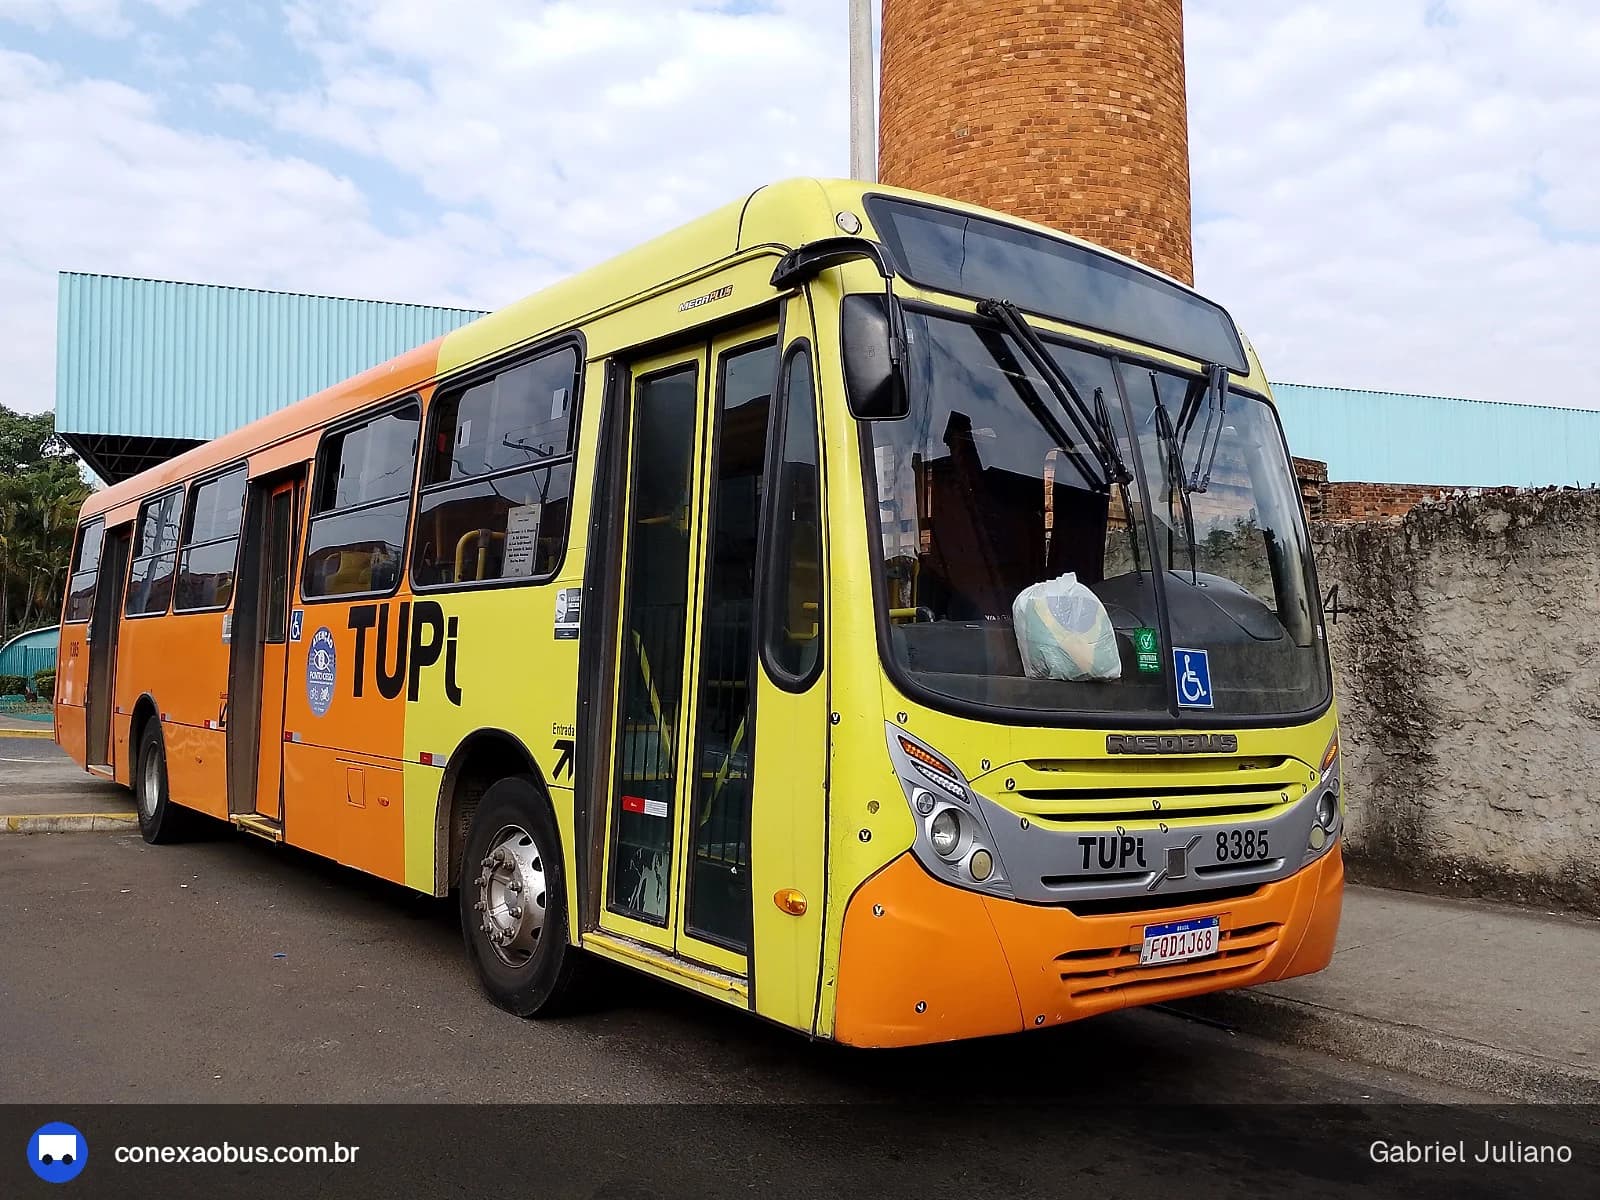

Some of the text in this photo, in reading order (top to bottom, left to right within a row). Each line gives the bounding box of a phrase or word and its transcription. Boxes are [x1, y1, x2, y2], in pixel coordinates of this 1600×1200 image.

[552, 722, 575, 737] Entrada
[1106, 734, 1238, 754] NEOBUS
[1215, 829, 1269, 862] 8385
[1149, 929, 1212, 960] FQD1J68
